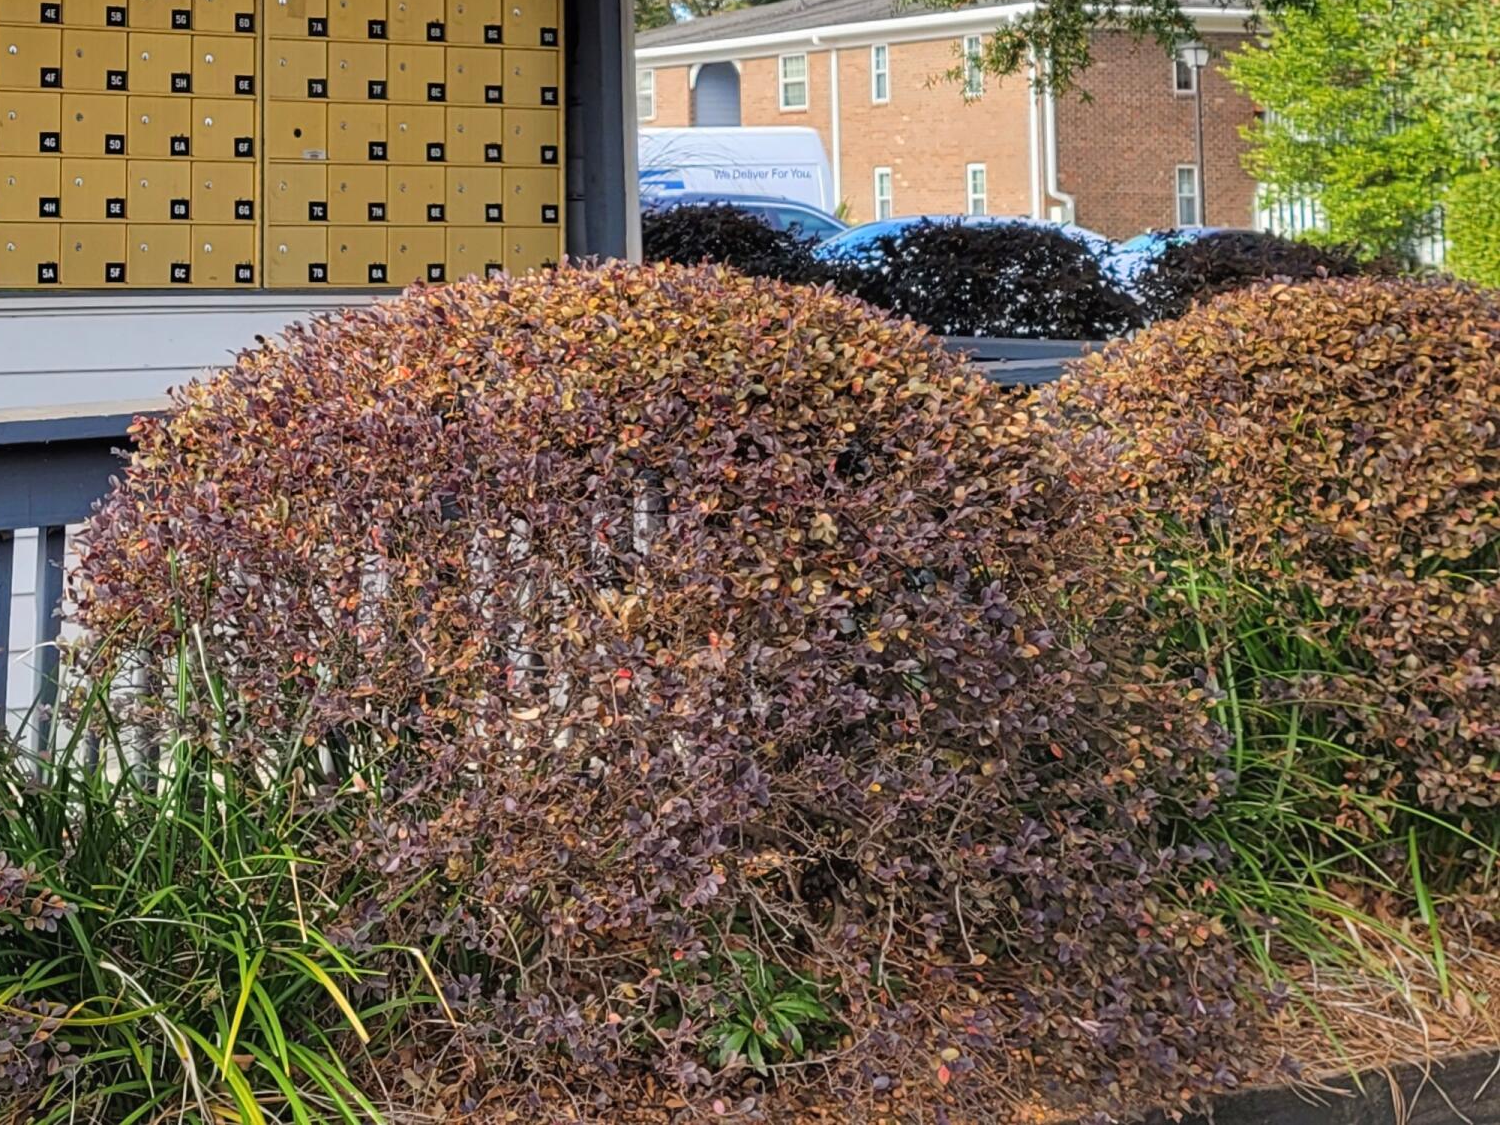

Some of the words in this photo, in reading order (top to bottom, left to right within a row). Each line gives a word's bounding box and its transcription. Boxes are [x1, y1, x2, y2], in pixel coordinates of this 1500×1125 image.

[44, 8, 56, 19] 4E
[110, 11, 122, 22] 5B
[175, 14, 187, 25] 5G
[312, 22, 323, 32] 7A
[372, 24, 382, 35] 7E
[44, 72, 56, 83] 4F
[110, 75, 123, 86] 5C
[175, 78, 187, 88] 5H
[311, 83, 323, 94] 7B
[372, 85, 382, 95] 7F
[43, 137, 56, 148] 4G
[372, 146, 383, 156] 7G
[714, 169, 731, 180] We
[732, 168, 769, 180] Deliver
[771, 167, 788, 180] For
[43, 202, 56, 213] 4H
[110, 203, 121, 214] 5E
[312, 206, 324, 217] 7C
[371, 207, 383, 217] 7H
[42, 268, 54, 279] 5A
[110, 267, 121, 278] 5F
[312, 267, 324, 278] 7D
